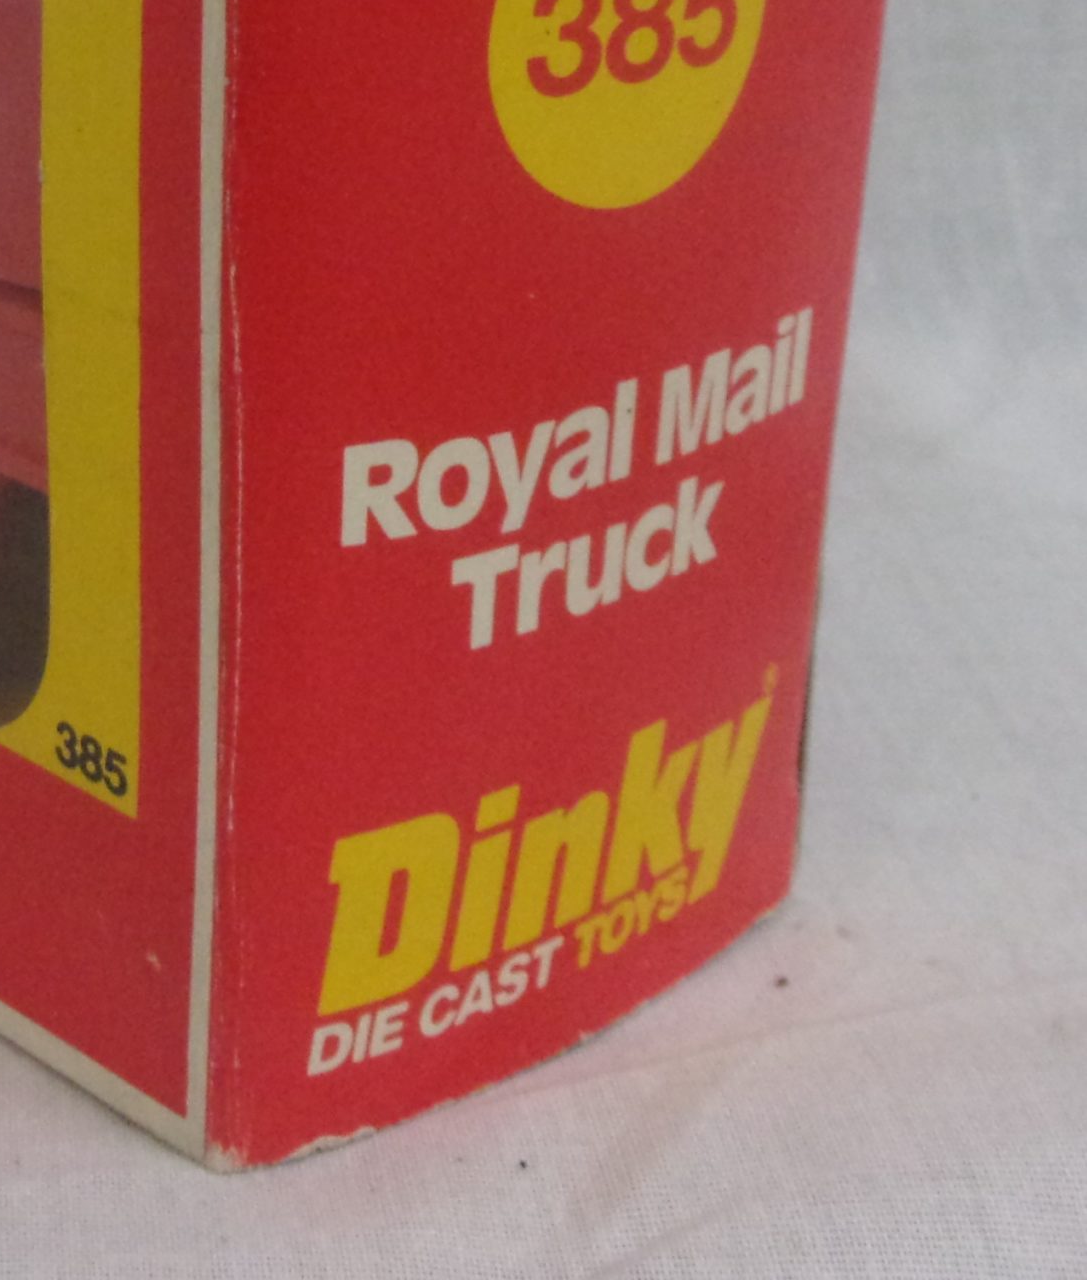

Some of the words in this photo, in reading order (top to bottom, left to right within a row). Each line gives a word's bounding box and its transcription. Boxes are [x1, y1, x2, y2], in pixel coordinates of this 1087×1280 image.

[340, 376, 638, 547] Royal
[655, 307, 814, 465] Mail
[451, 476, 725, 651] Truck
[54, 721, 129, 797] 385
[317, 695, 774, 1016] Dinky
[306, 1001, 410, 1077] DIE
[418, 936, 564, 1037] CAST
[572, 866, 686, 970] TOYS
